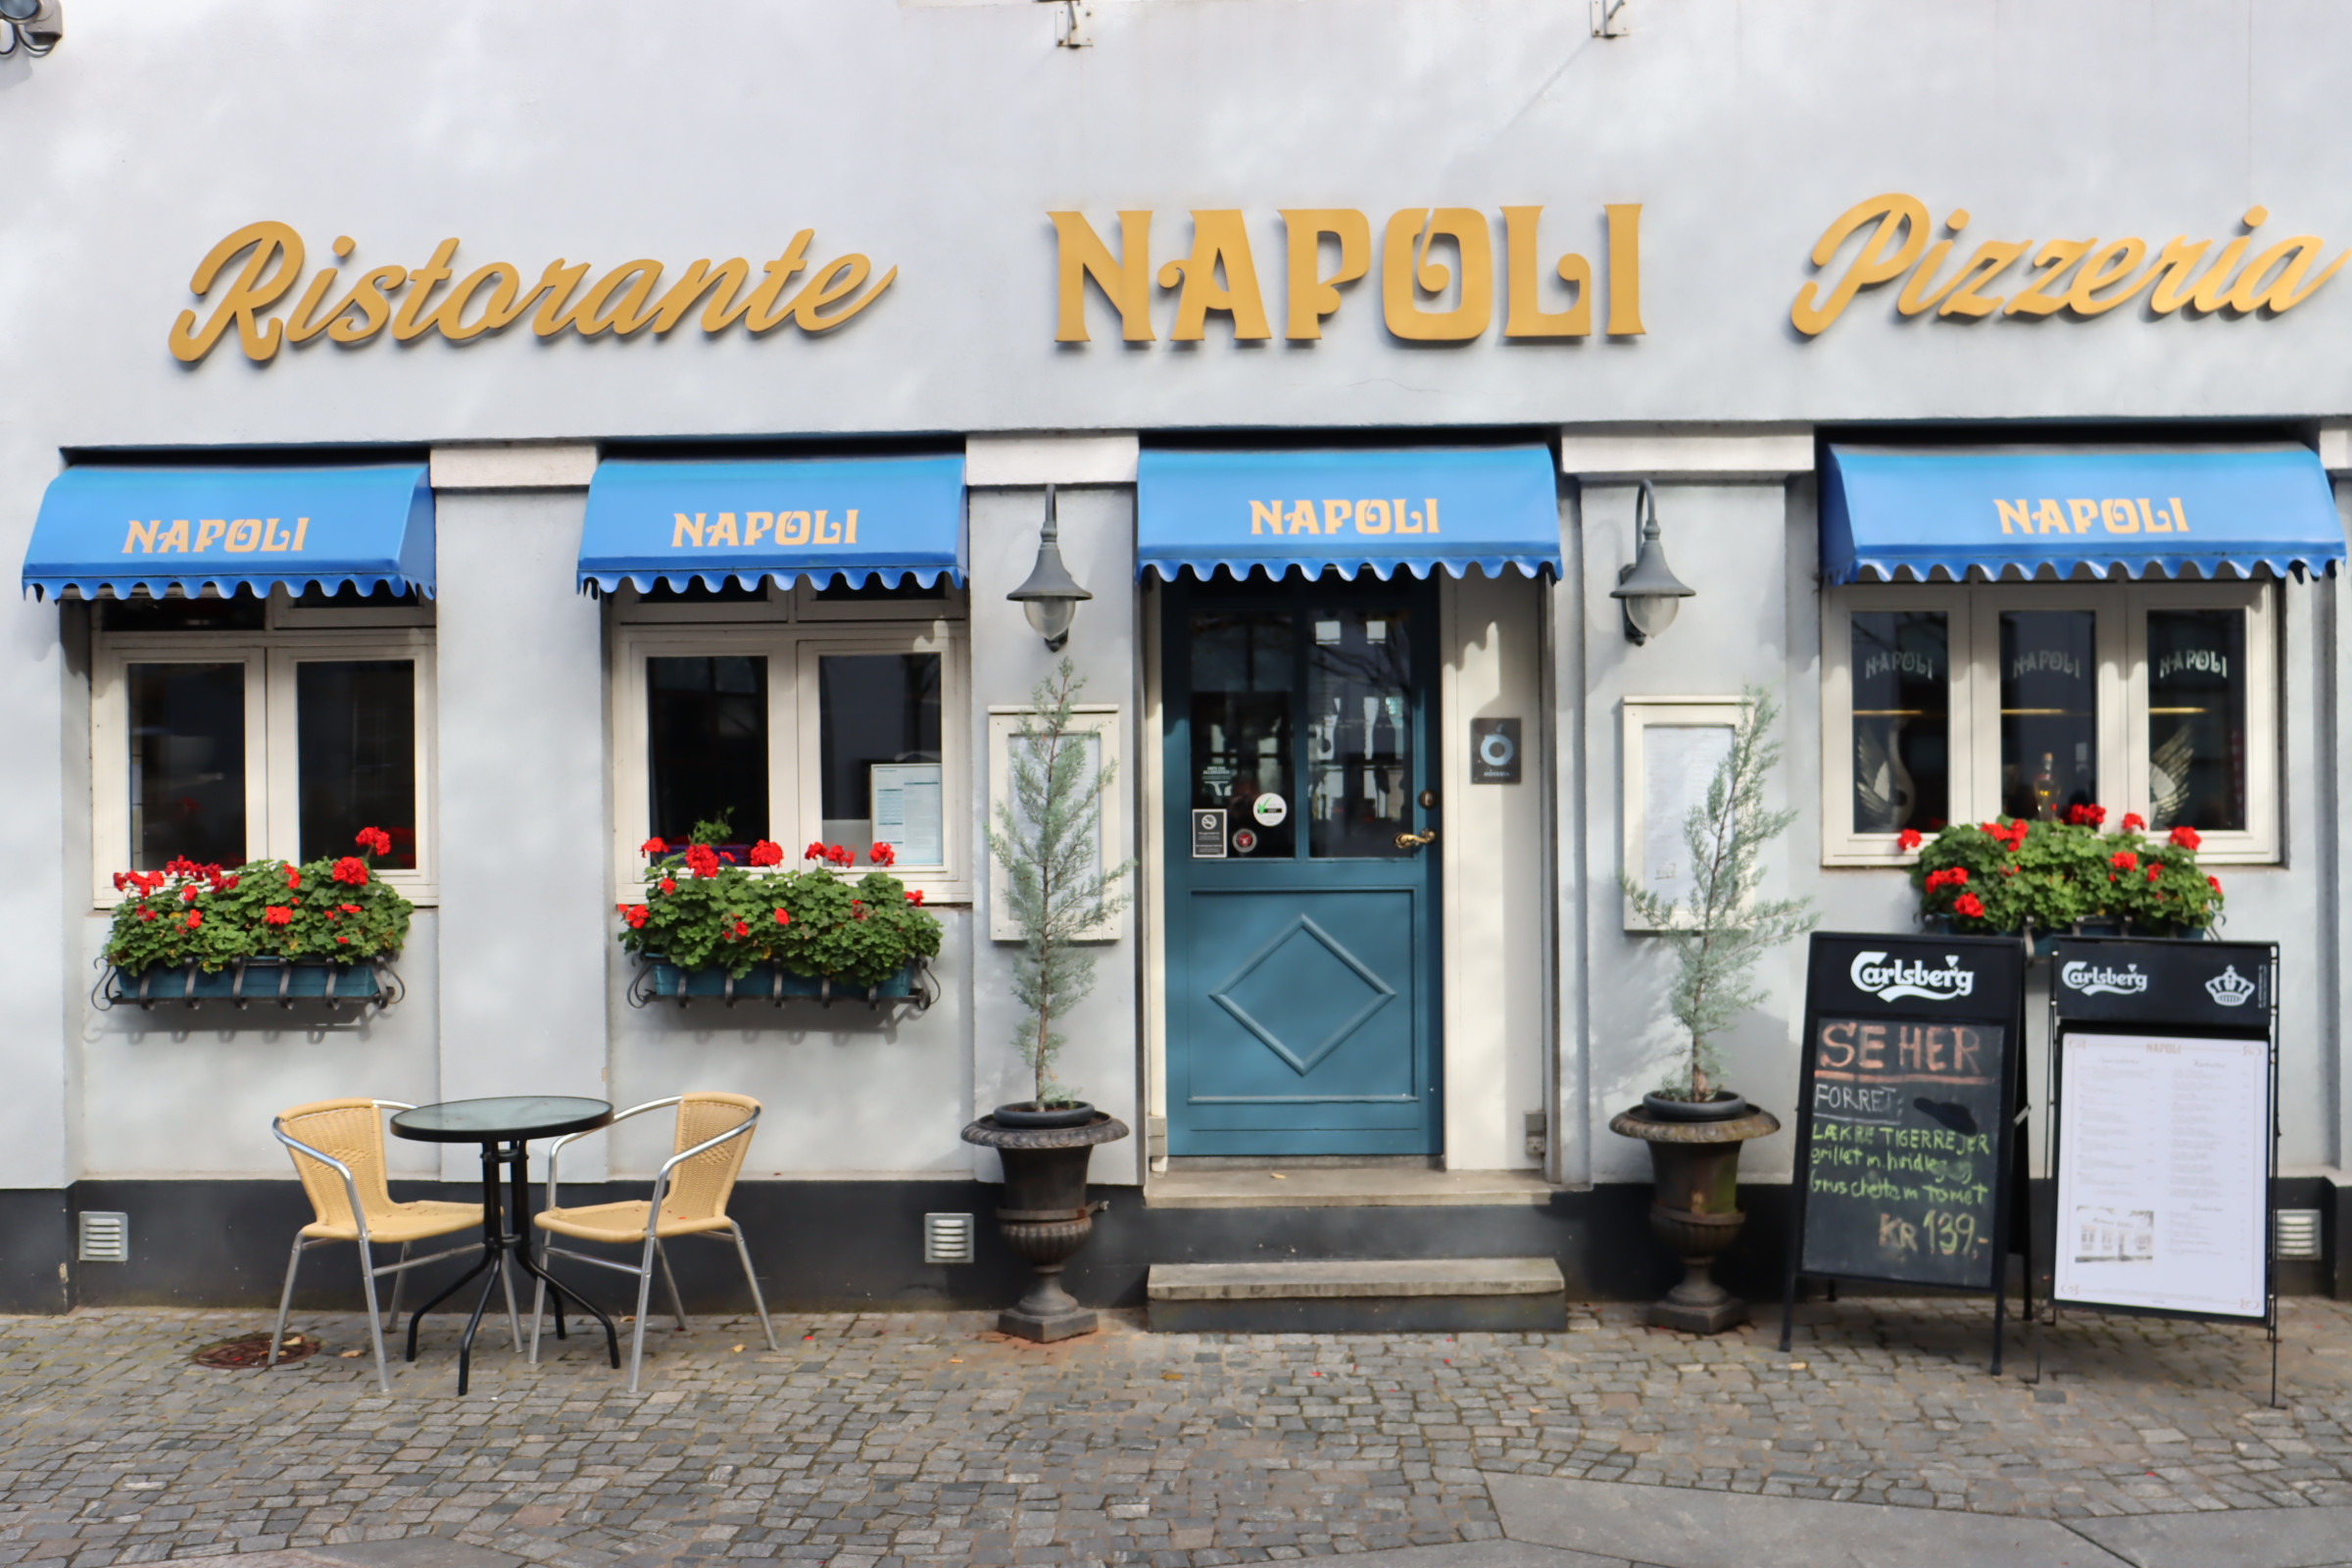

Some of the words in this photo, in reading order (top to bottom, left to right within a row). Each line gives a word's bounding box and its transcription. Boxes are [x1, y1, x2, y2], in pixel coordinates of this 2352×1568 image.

[1048, 203, 1646, 342] NAPOLI
[1790, 193, 2350, 335] Pizzeria
[170, 220, 898, 362] Ristorante
[671, 509, 859, 548] NAPOLI
[1250, 498, 1441, 535] NAPOLI
[1993, 497, 2190, 534] NAPOLI
[122, 516, 310, 554] NAPOLI
[1865, 651, 1934, 680] NAPOLI
[2012, 649, 2082, 679] NAPOLI
[2159, 649, 2228, 679] NAPOLI
[1850, 951, 1975, 1003] Carlsberg
[2061, 960, 2148, 996] Carlsberg
[1820, 1021, 1886, 1070] SE
[1898, 1026, 1981, 1074] HER
